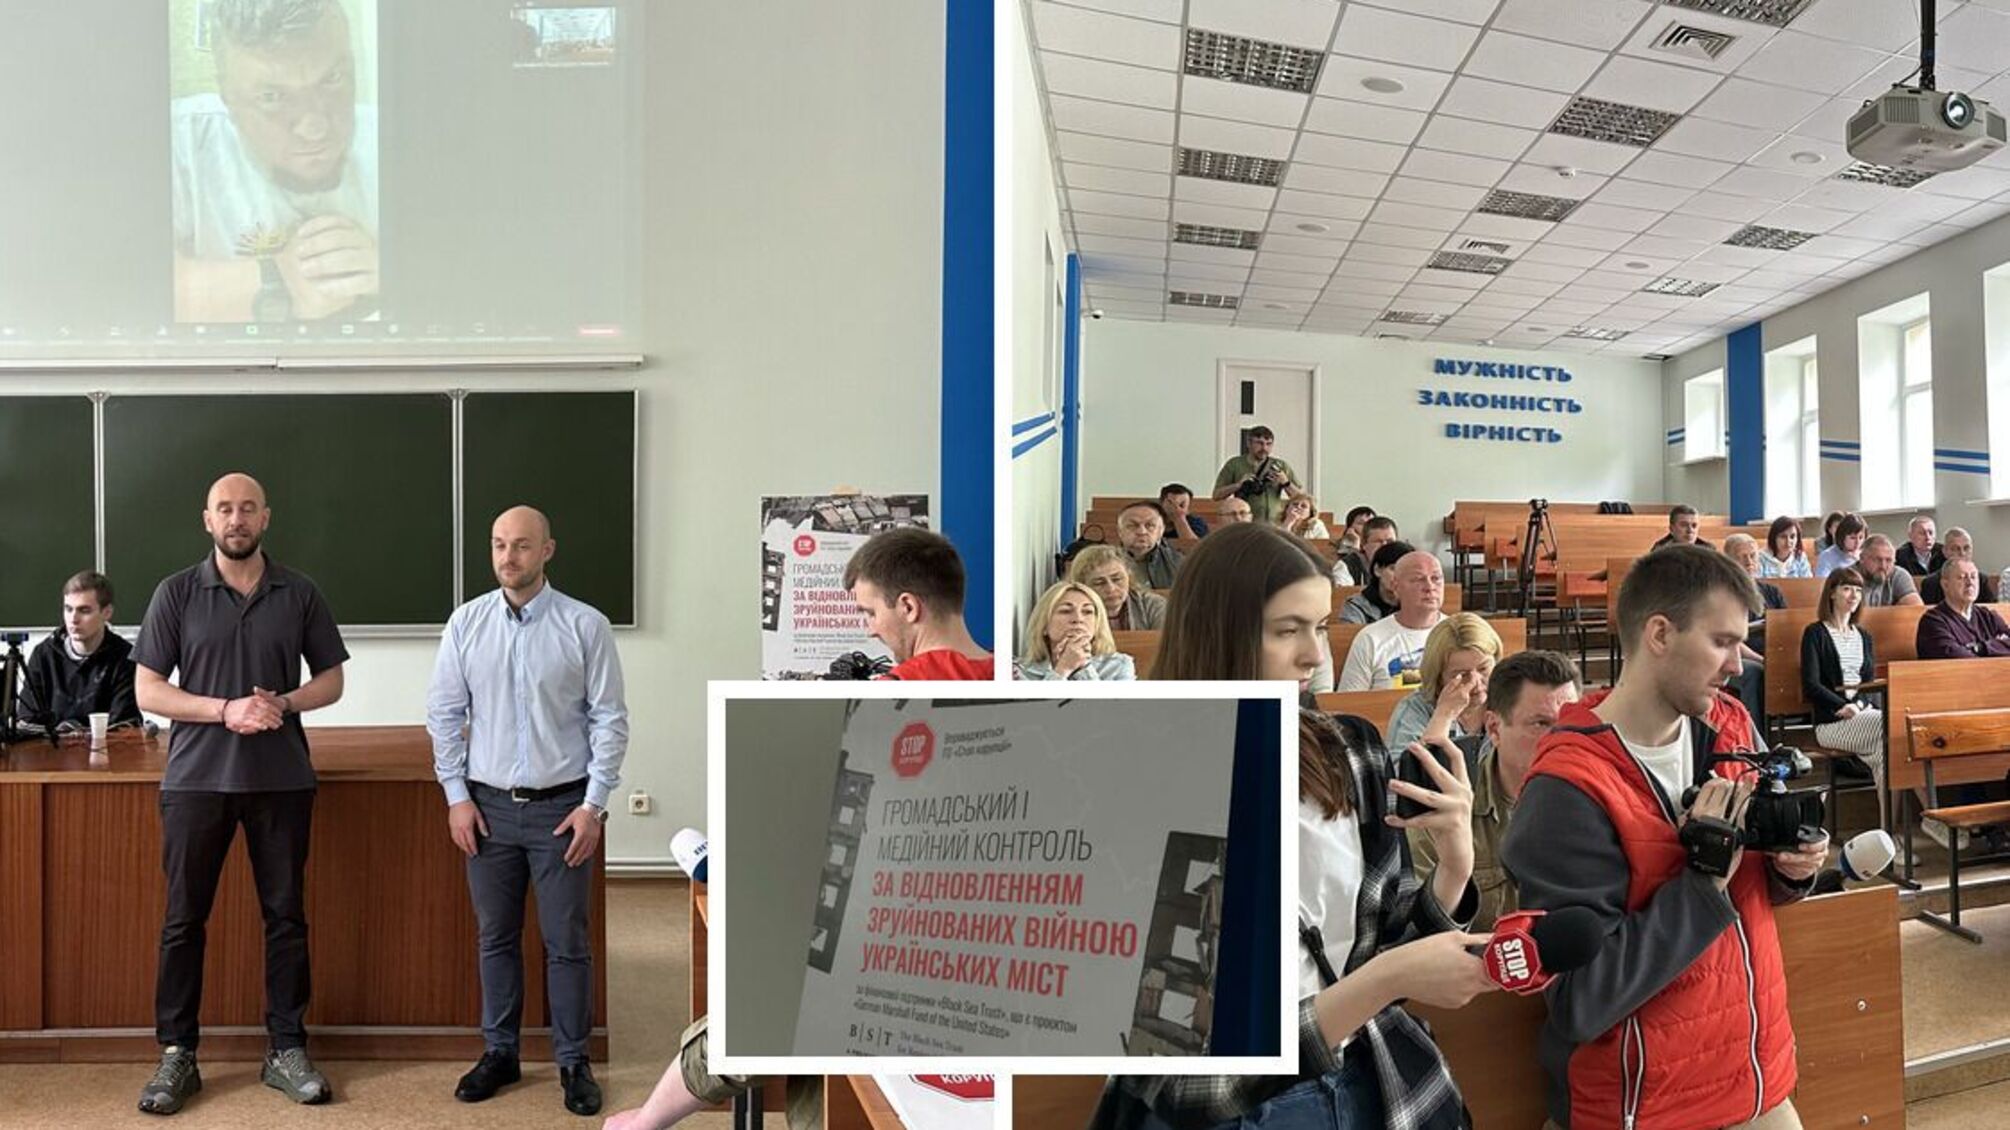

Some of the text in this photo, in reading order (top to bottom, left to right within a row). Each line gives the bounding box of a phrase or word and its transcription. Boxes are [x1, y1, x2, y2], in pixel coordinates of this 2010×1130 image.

[1433, 358, 1573, 383] МУЖНІСТЬ
[1417, 390, 1583, 413] ЗАКОННІСТЬ
[1444, 423, 1563, 443] ВІРНІСТЬ
[793, 590, 806, 602] ЗА
[900, 735, 927, 756] STOP
[882, 785, 1019, 826] ГРОМАДСЬКИЙ
[877, 828, 1093, 866] МЕДІЙНИЙ КОНТРОЛЬ
[872, 870, 1085, 907] ЗА ВІДНОВЛЕННЯМ
[867, 903, 1139, 958] ЗРУЙНОВАНИХ ВІЙНОЮ
[860, 940, 1069, 998] УКРАЇНСЬКИХ МІСТ
[1501, 938, 1529, 980] STOP
